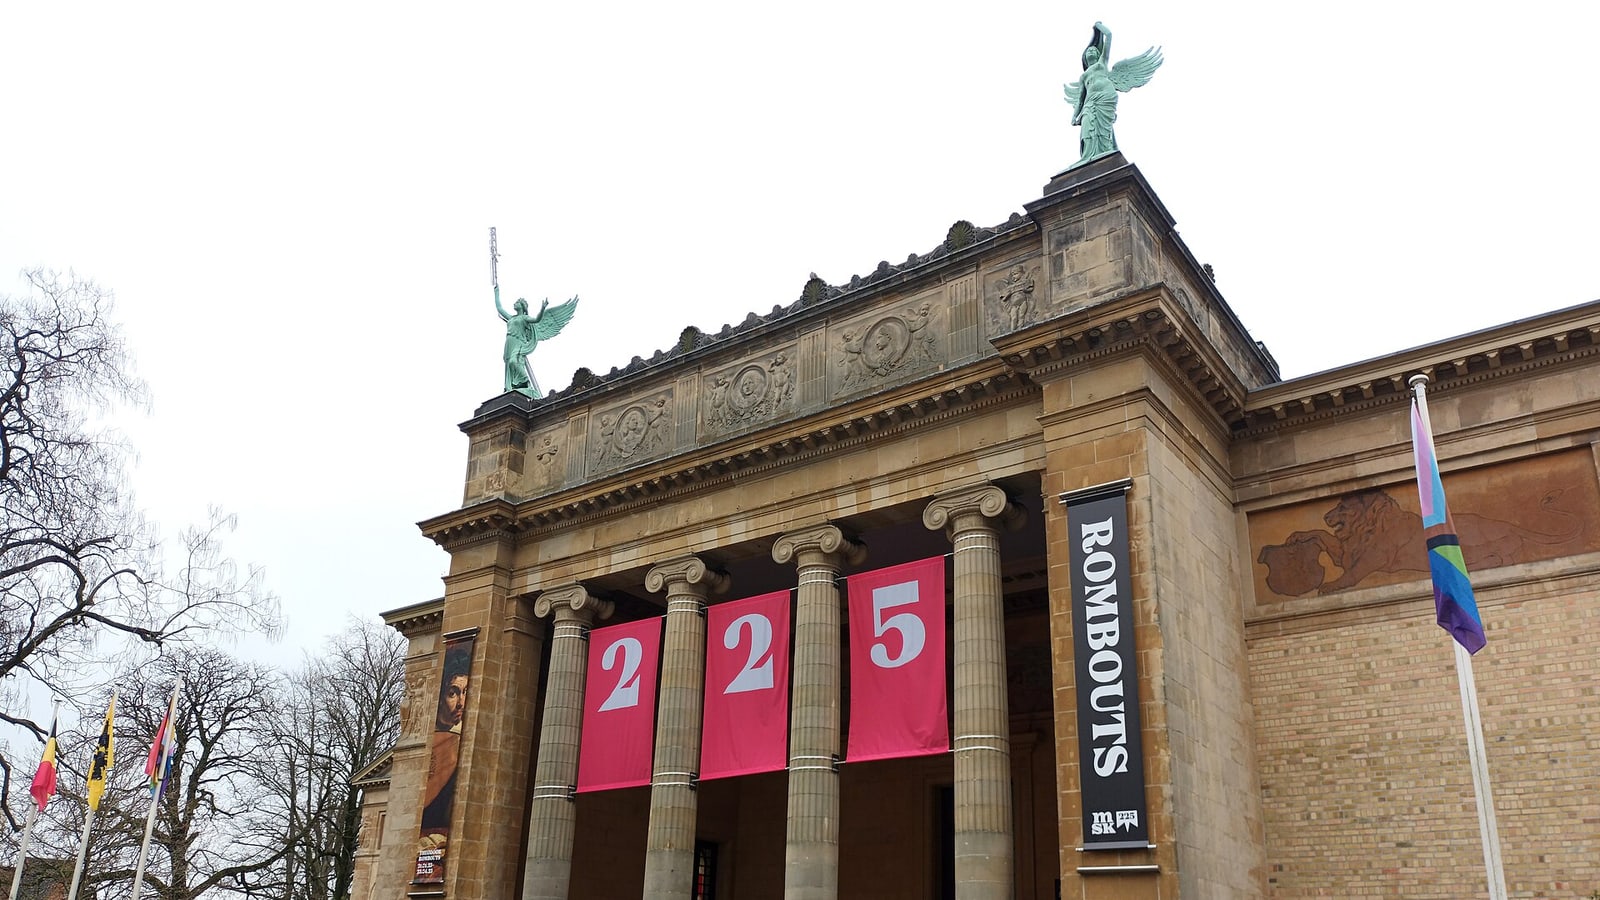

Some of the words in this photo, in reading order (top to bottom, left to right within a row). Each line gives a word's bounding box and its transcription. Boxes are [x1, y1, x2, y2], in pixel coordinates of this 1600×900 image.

[722, 613, 774, 695] 2
[870, 580, 926, 668] 5
[1081, 516, 1128, 778] ROMBOUTS
[597, 637, 643, 713] 2
[1118, 812, 1135, 820] 225
